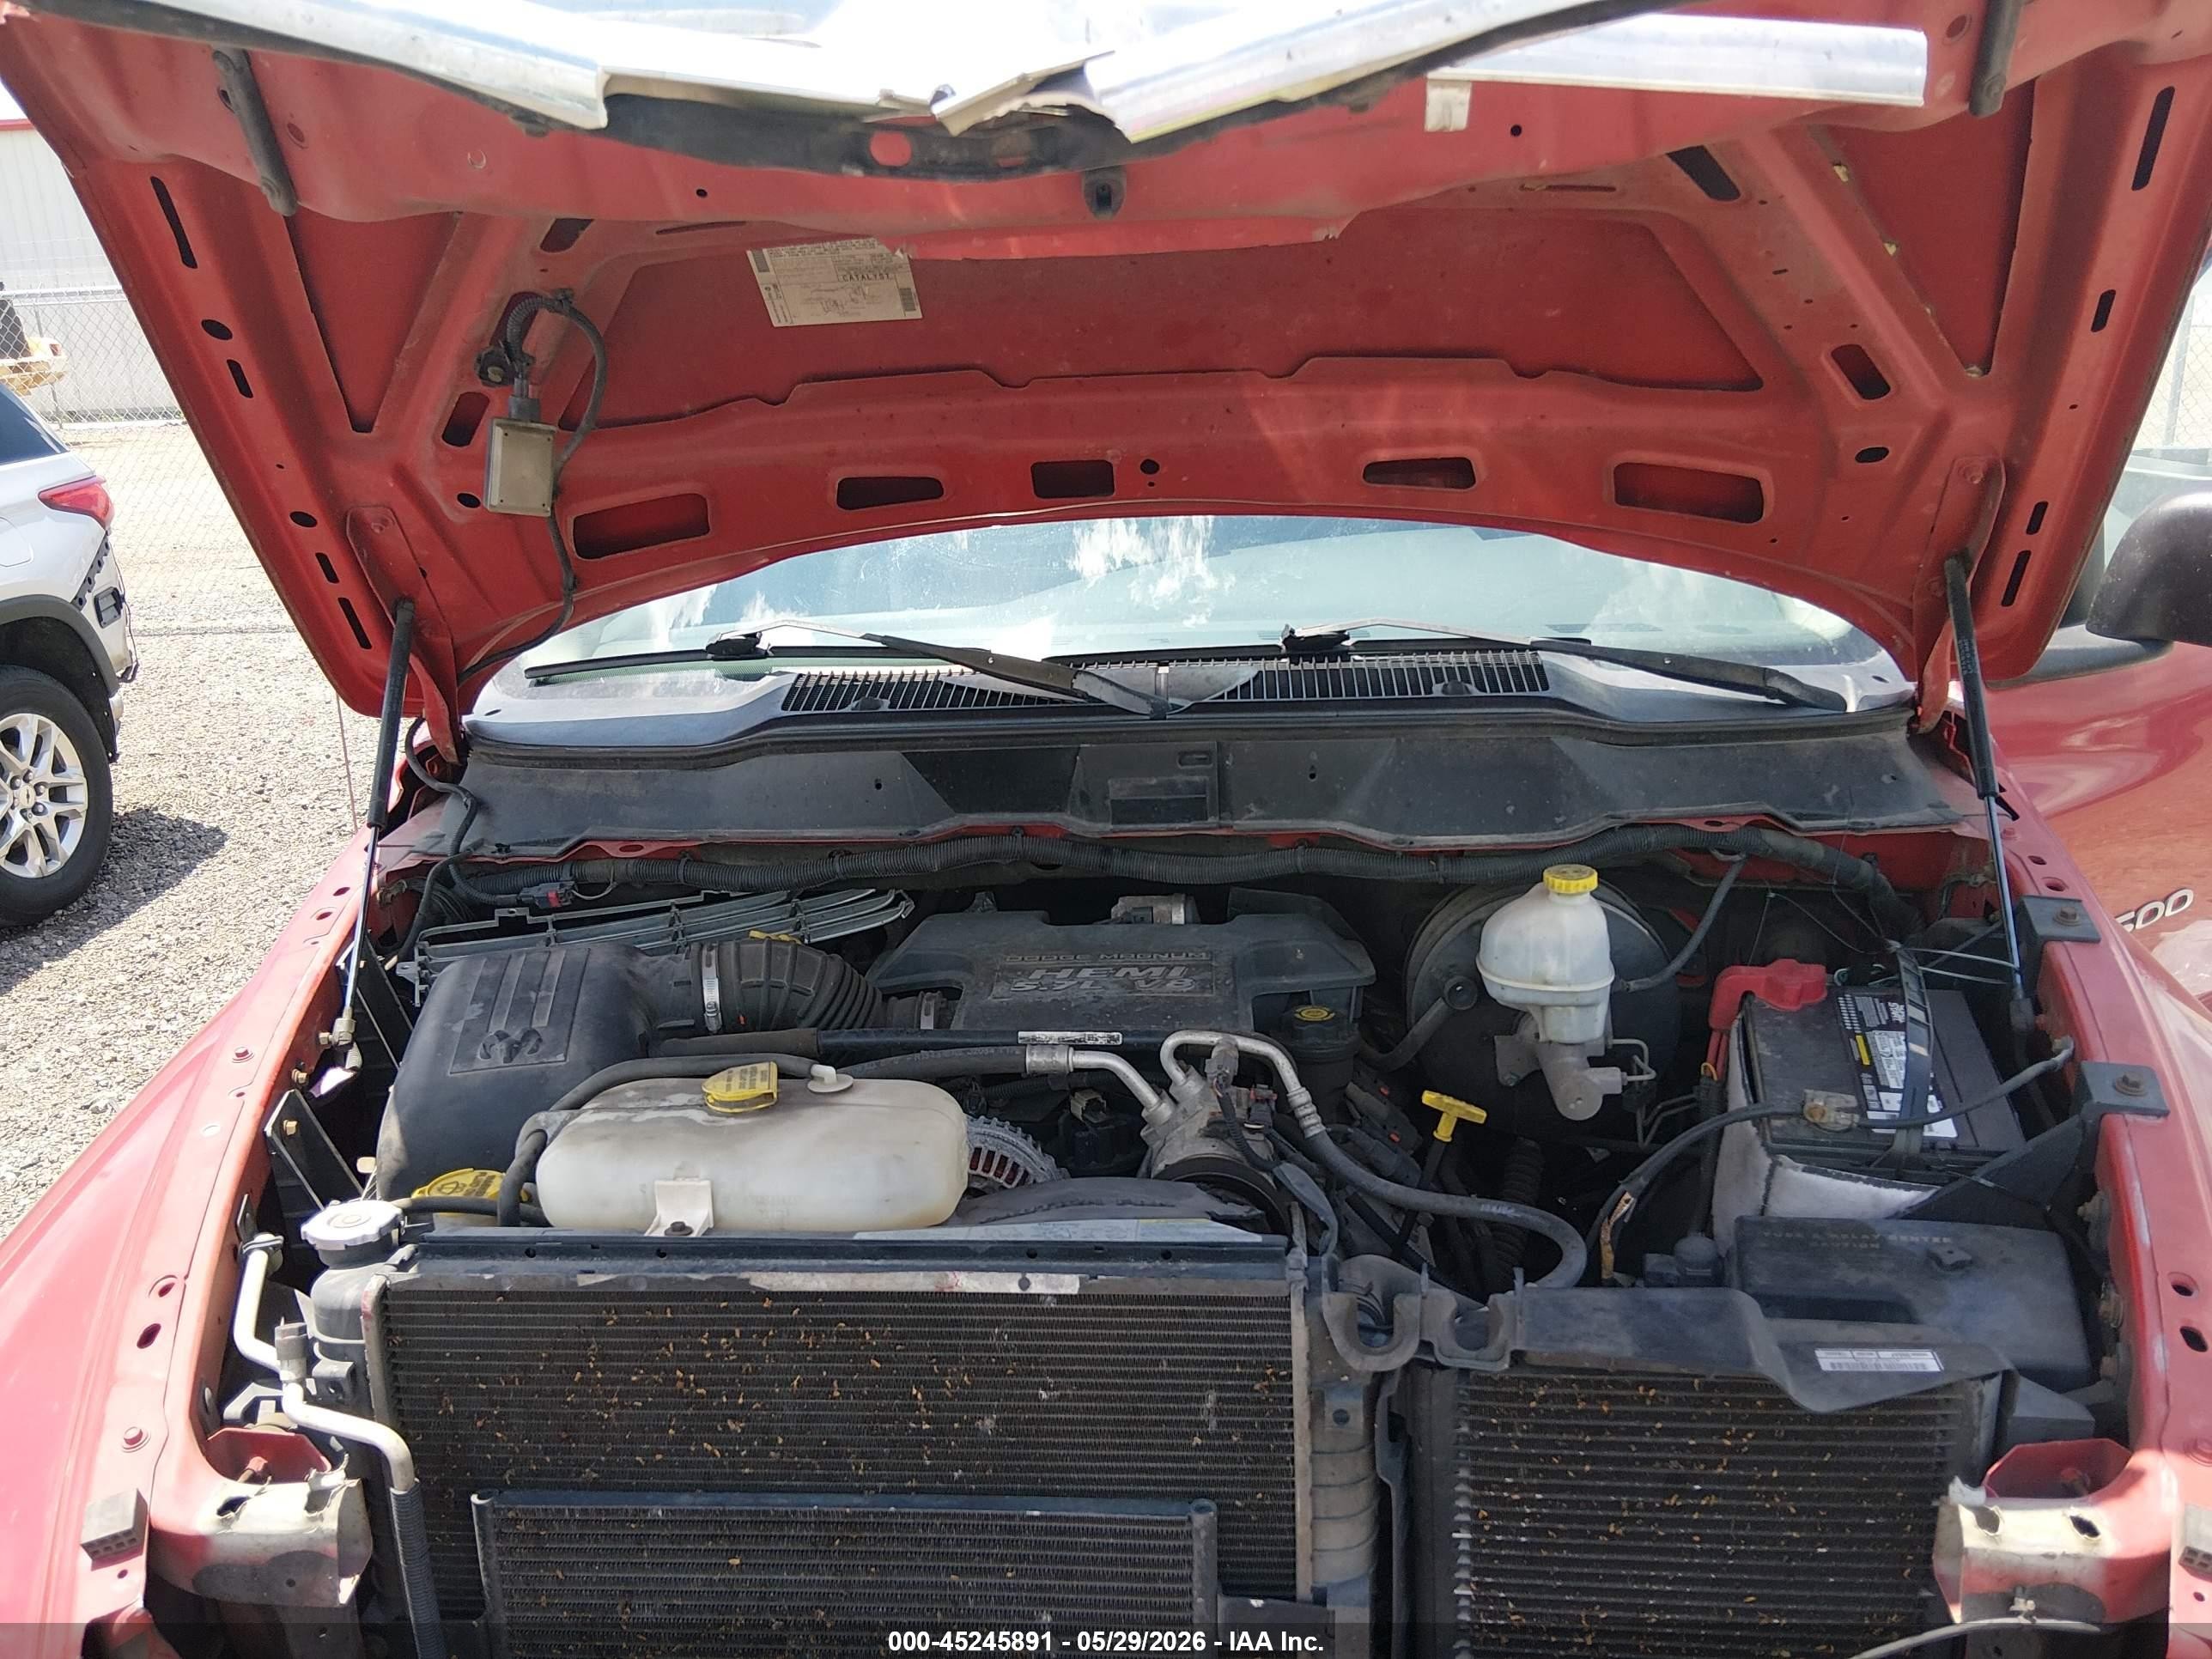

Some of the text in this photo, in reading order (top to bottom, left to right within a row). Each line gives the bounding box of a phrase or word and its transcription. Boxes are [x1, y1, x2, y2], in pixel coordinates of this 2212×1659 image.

[1099, 951, 1208, 961] MAGNUM
[1028, 965, 1189, 980] HEMI
[1010, 978, 1196, 992] 5.7L V8
